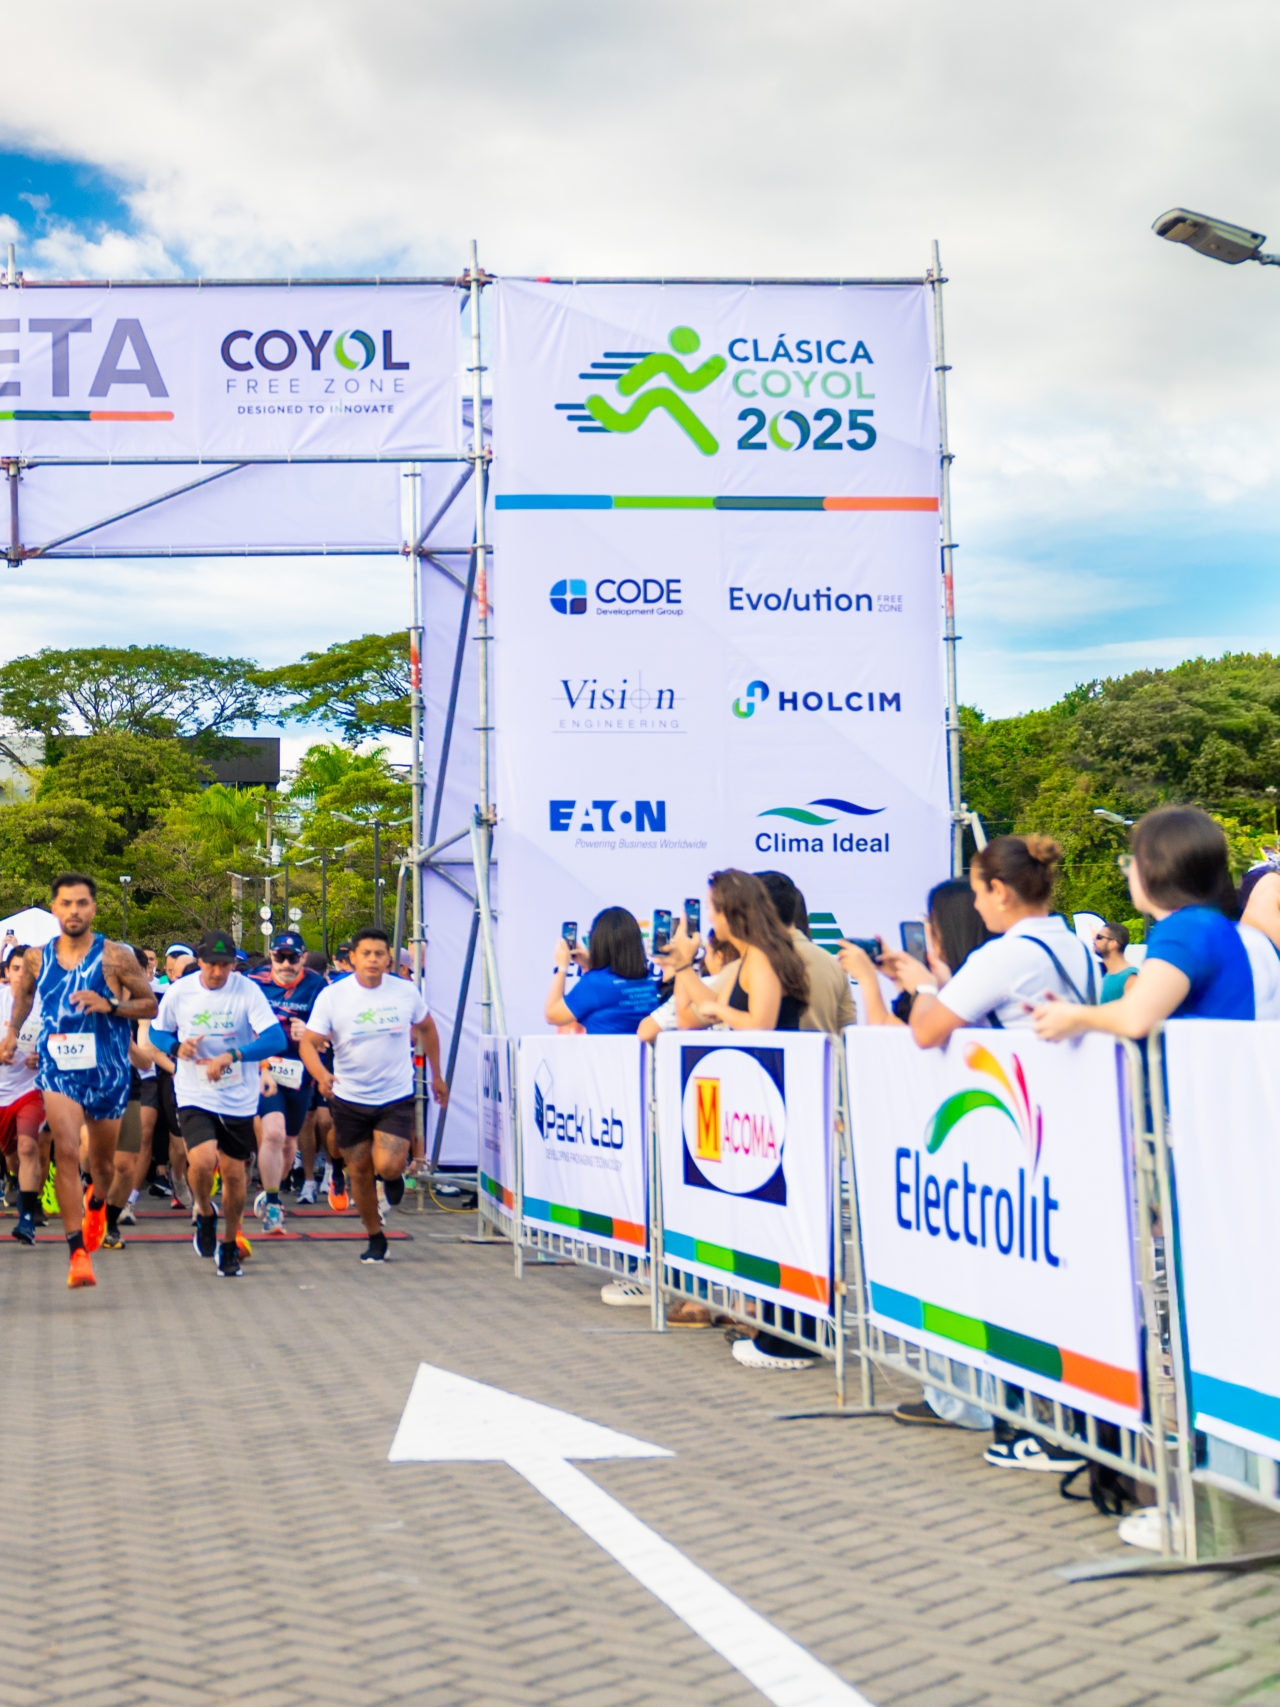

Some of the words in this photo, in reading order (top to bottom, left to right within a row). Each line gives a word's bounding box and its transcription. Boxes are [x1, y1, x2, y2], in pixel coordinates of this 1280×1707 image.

[221, 329, 410, 371] COYOL
[728, 333, 873, 364] CLÁSICA
[226, 378, 300, 394] FREE
[324, 378, 405, 394] ZONE
[732, 368, 875, 400] COYOL
[237, 405, 303, 414] DESIGNED
[309, 405, 325, 414] TO
[330, 401, 395, 414] INNOVATE
[737, 407, 877, 451] 2025
[595, 579, 682, 604] CODE
[877, 594, 903, 603] FREE
[596, 607, 654, 616] Development
[656, 607, 683, 616] Group
[877, 604, 903, 613] ZONE
[560, 678, 675, 710] Vision
[778, 691, 901, 712] HOLCIM
[559, 719, 680, 729] ENGINEERING
[549, 800, 666, 832] EATON
[574, 838, 617, 850] Powering
[618, 838, 657, 849] Business
[659, 838, 708, 849] Worldwide
[755, 832, 824, 853] Clima
[832, 832, 890, 853] Ideal
[57, 1044, 84, 1055] 1367
[545, 1103, 585, 1145] Pack
[589, 1107, 624, 1150] Lab
[895, 1146, 1060, 1268] Electrolit
